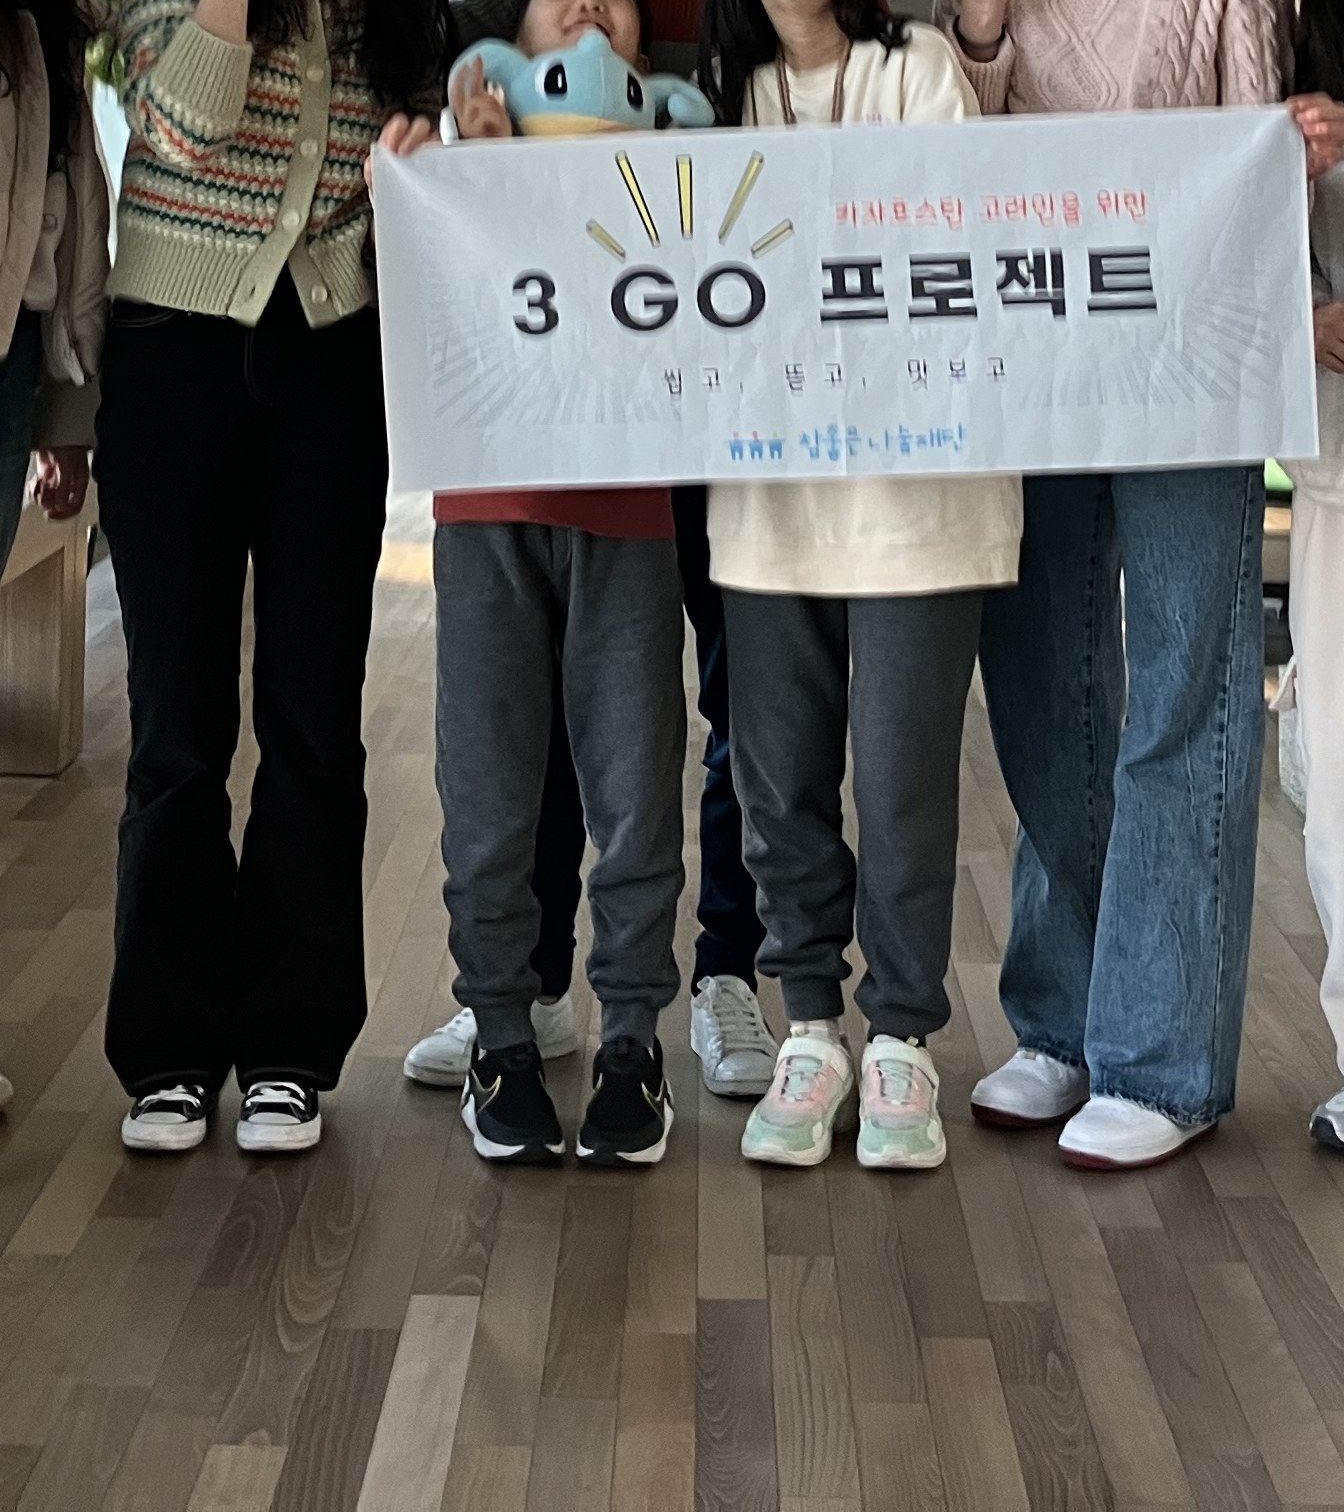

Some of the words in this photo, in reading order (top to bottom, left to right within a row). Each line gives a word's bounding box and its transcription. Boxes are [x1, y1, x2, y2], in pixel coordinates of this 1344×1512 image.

[980, 192, 1082, 228] 고려인을
[513, 268, 559, 335] 3
[611, 262, 765, 332] GO
[820, 246, 1157, 323] 프로젝트
